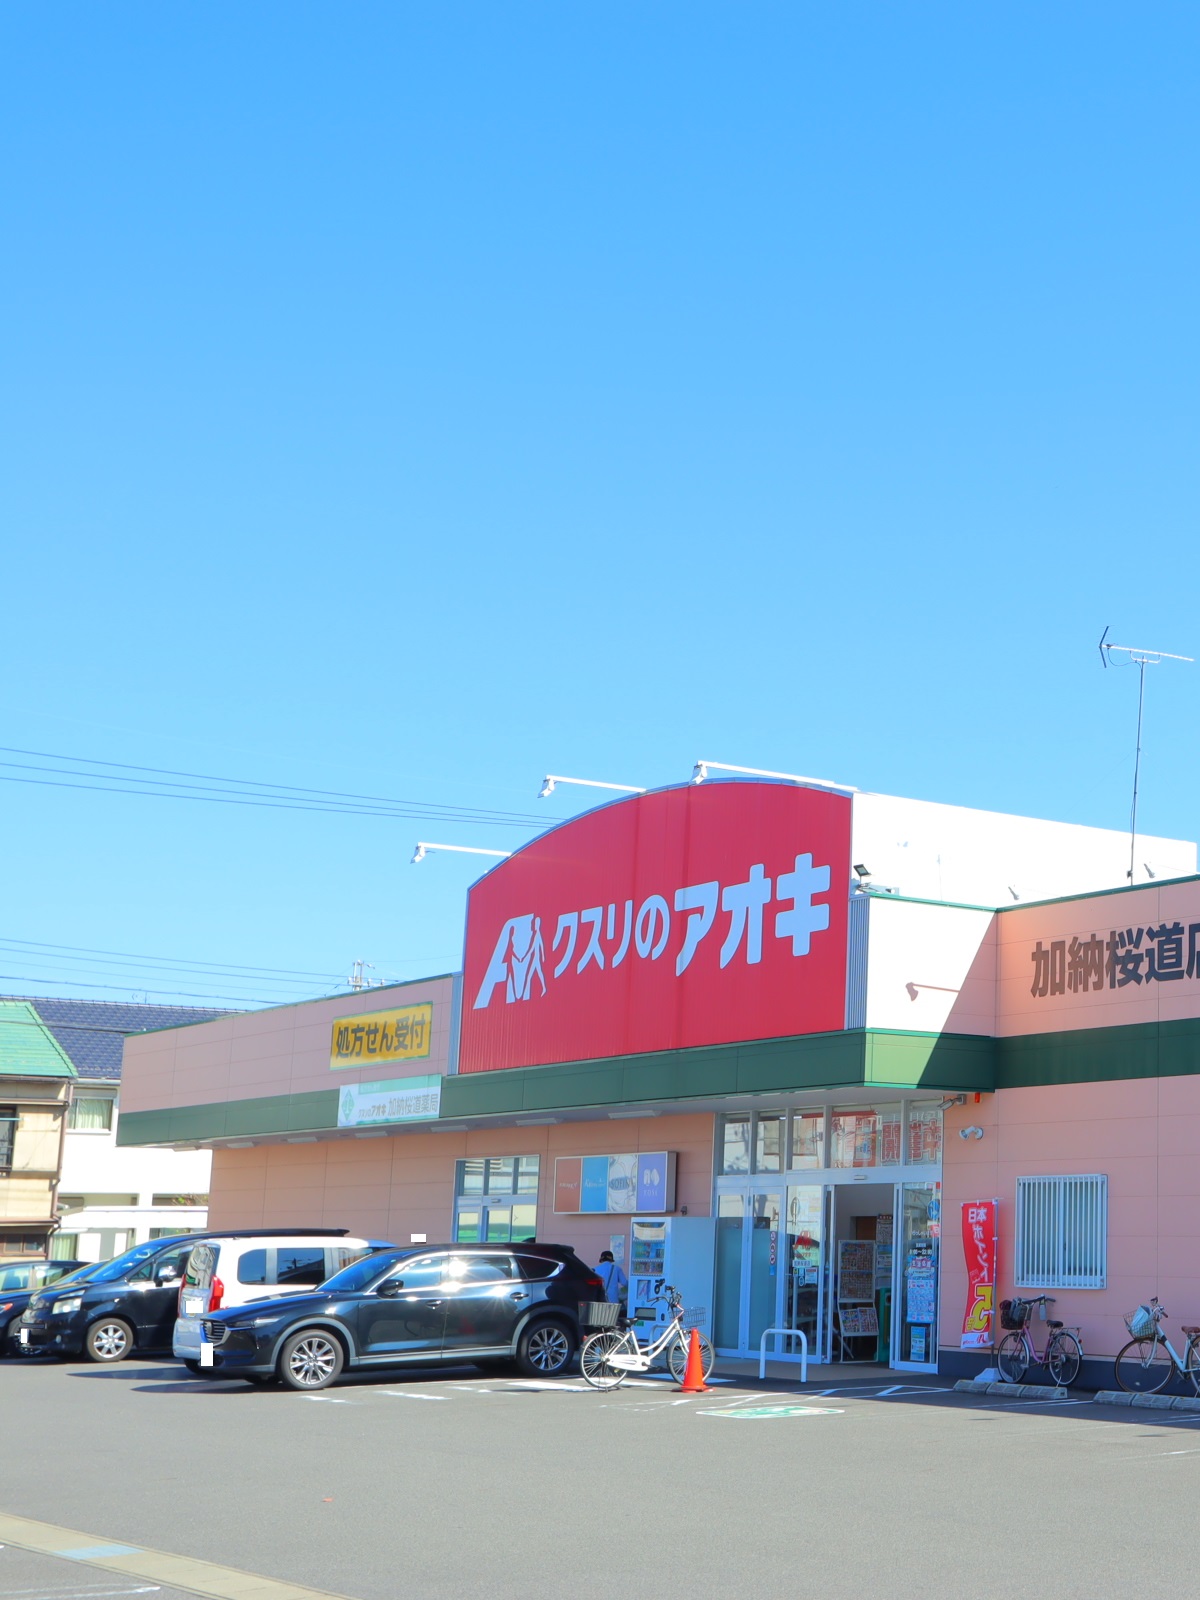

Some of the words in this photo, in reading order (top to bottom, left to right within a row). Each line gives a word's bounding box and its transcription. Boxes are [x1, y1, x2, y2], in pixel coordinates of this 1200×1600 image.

[552, 852, 831, 977] クスリのアオキ
[336, 1013, 426, 1059] 処方せん受付
